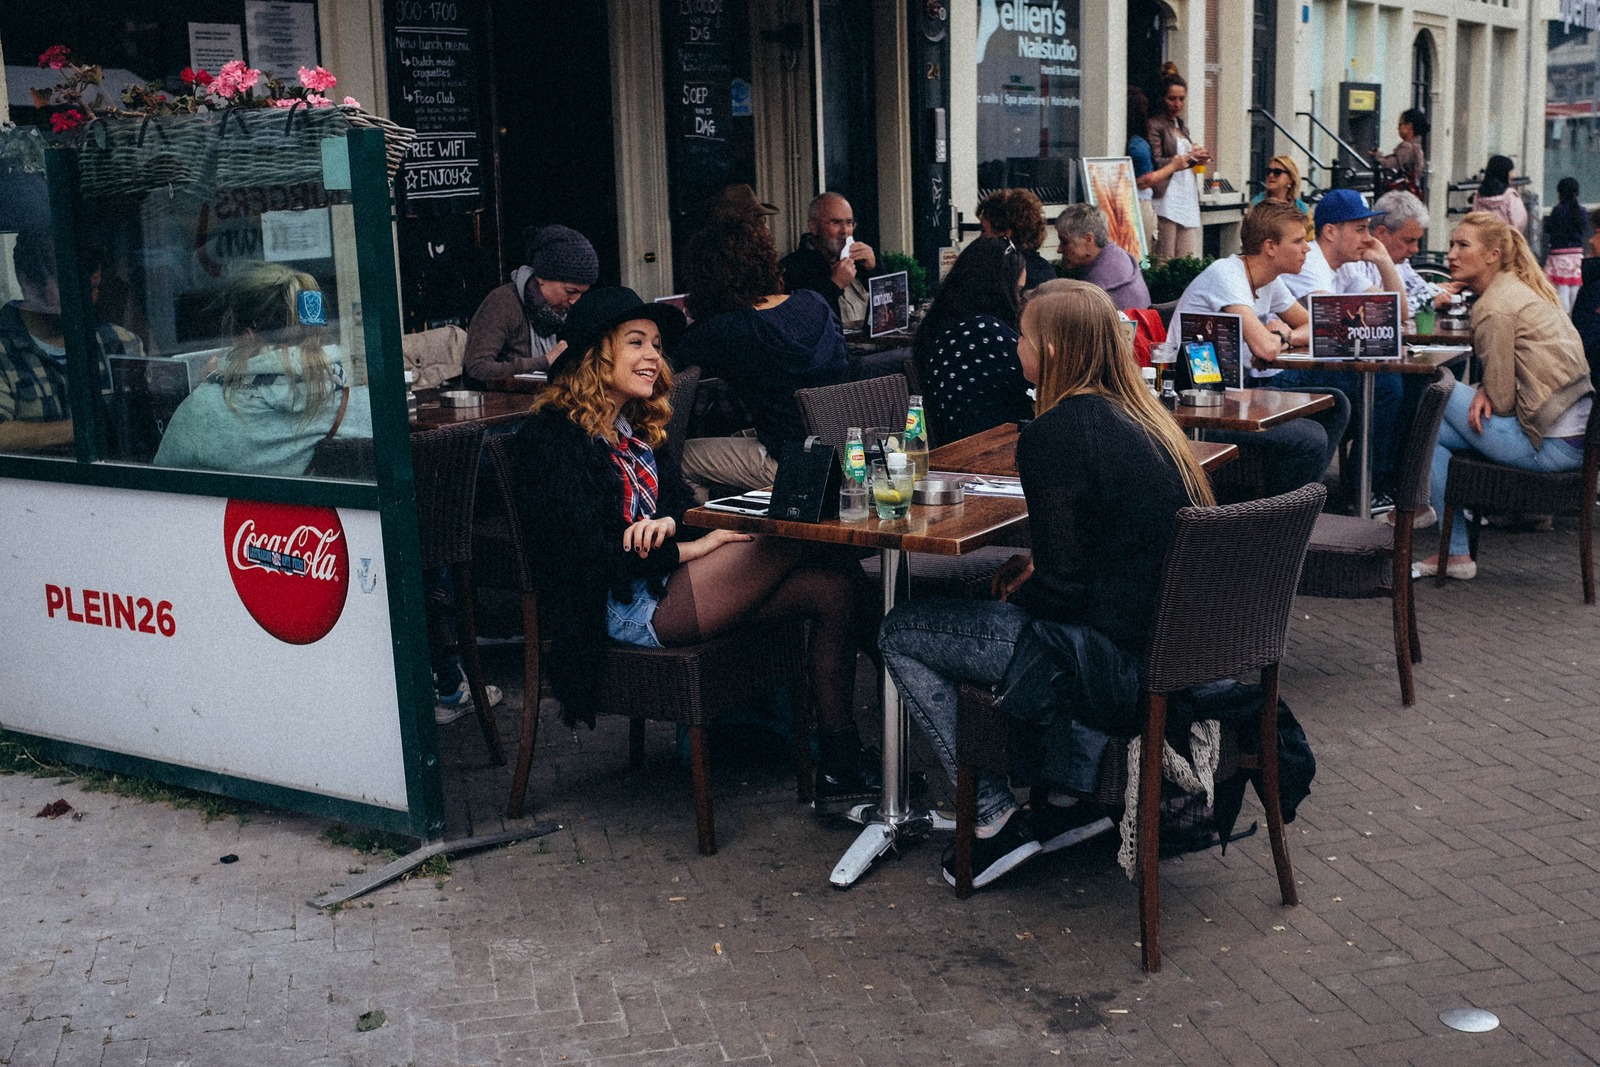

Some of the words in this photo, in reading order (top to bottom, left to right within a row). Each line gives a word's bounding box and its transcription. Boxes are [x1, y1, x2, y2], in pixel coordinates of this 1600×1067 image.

[689, 26, 711, 41] DAG
[395, 37, 416, 49] New
[418, 35, 443, 50] lunch
[1018, 36, 1077, 61] Nailstudio
[411, 55, 435, 67] Dutch
[412, 68, 451, 82] croquettes
[926, 62, 940, 80] 24
[436, 91, 456, 104] Club
[682, 84, 709, 105] SOEP
[982, 94, 998, 104] nails
[1004, 94, 1018, 106] Spa
[695, 116, 717, 136] DAG
[438, 139, 466, 157] WIFI
[420, 168, 459, 188] ENJOY
[1372, 326, 1394, 339] LOCO
[45, 583, 176, 638] PLEIN26
